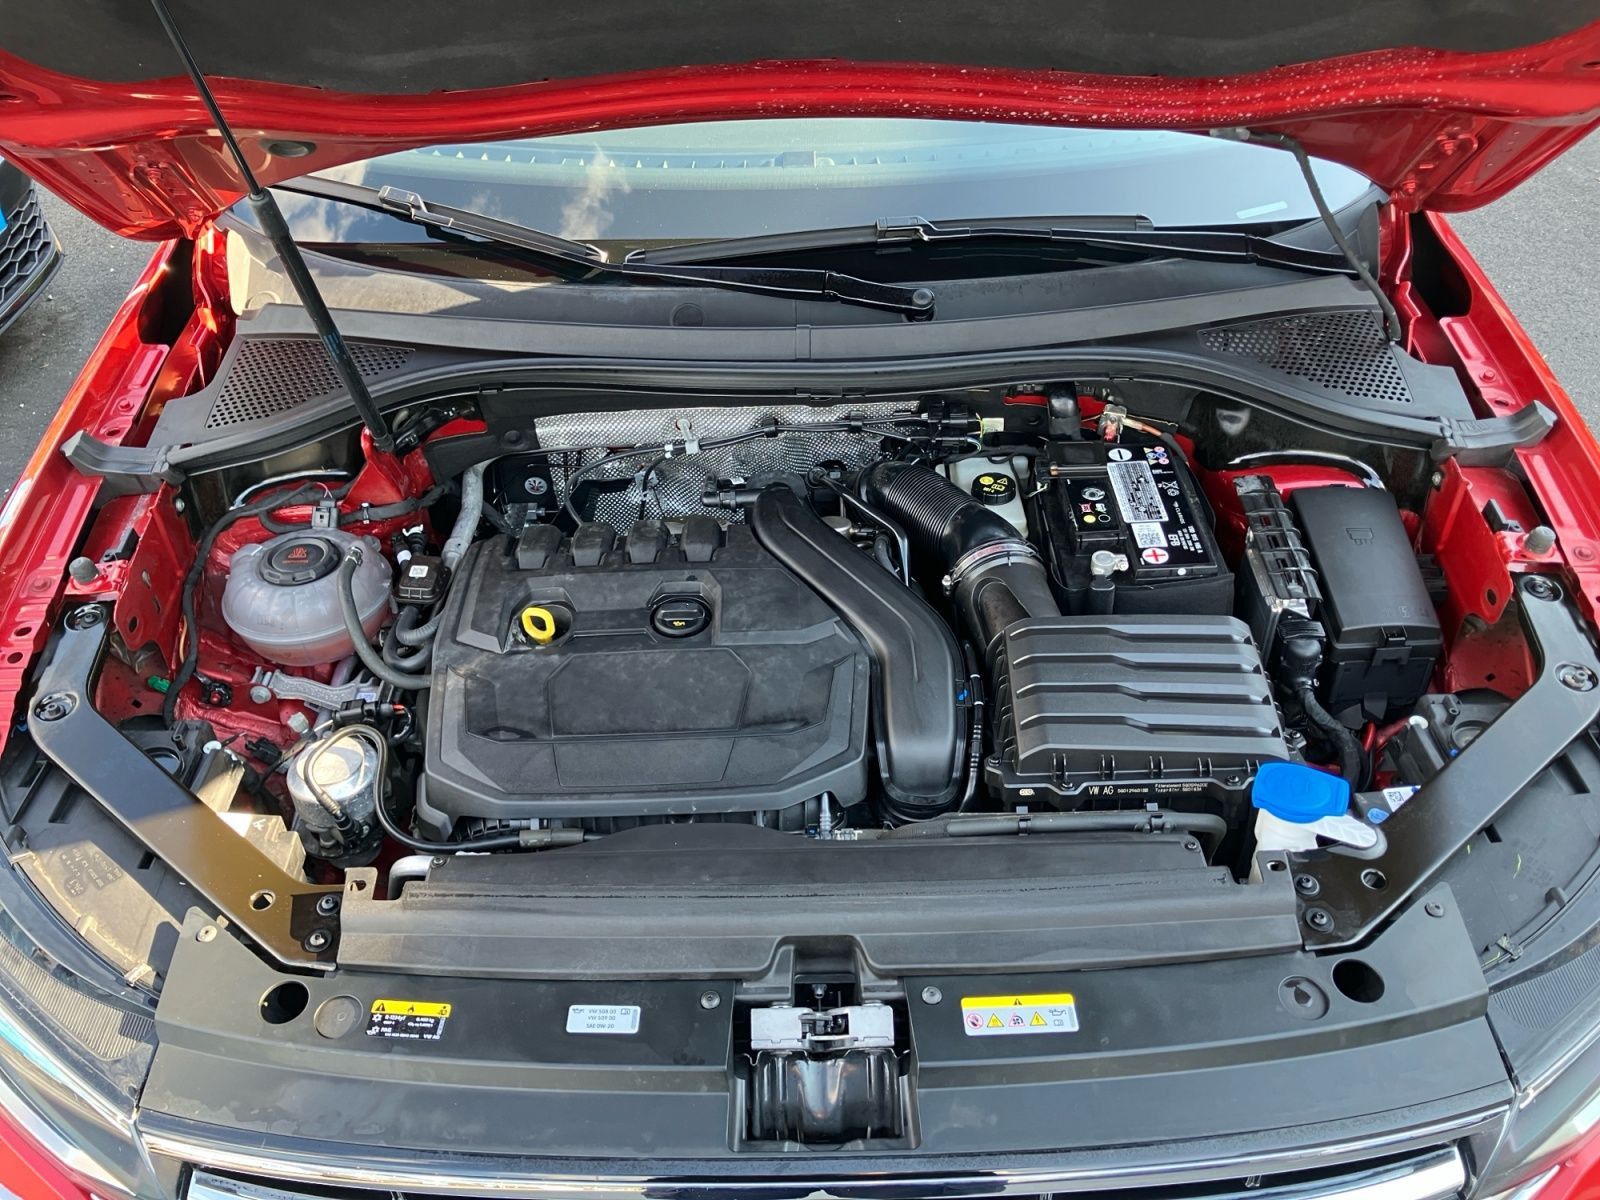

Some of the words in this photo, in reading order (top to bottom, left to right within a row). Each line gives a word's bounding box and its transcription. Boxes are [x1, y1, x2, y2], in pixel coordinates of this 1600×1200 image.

[1168, 534, 1181, 546] EFB
[1088, 786, 1100, 795] VW
[1102, 785, 1114, 795] AG
